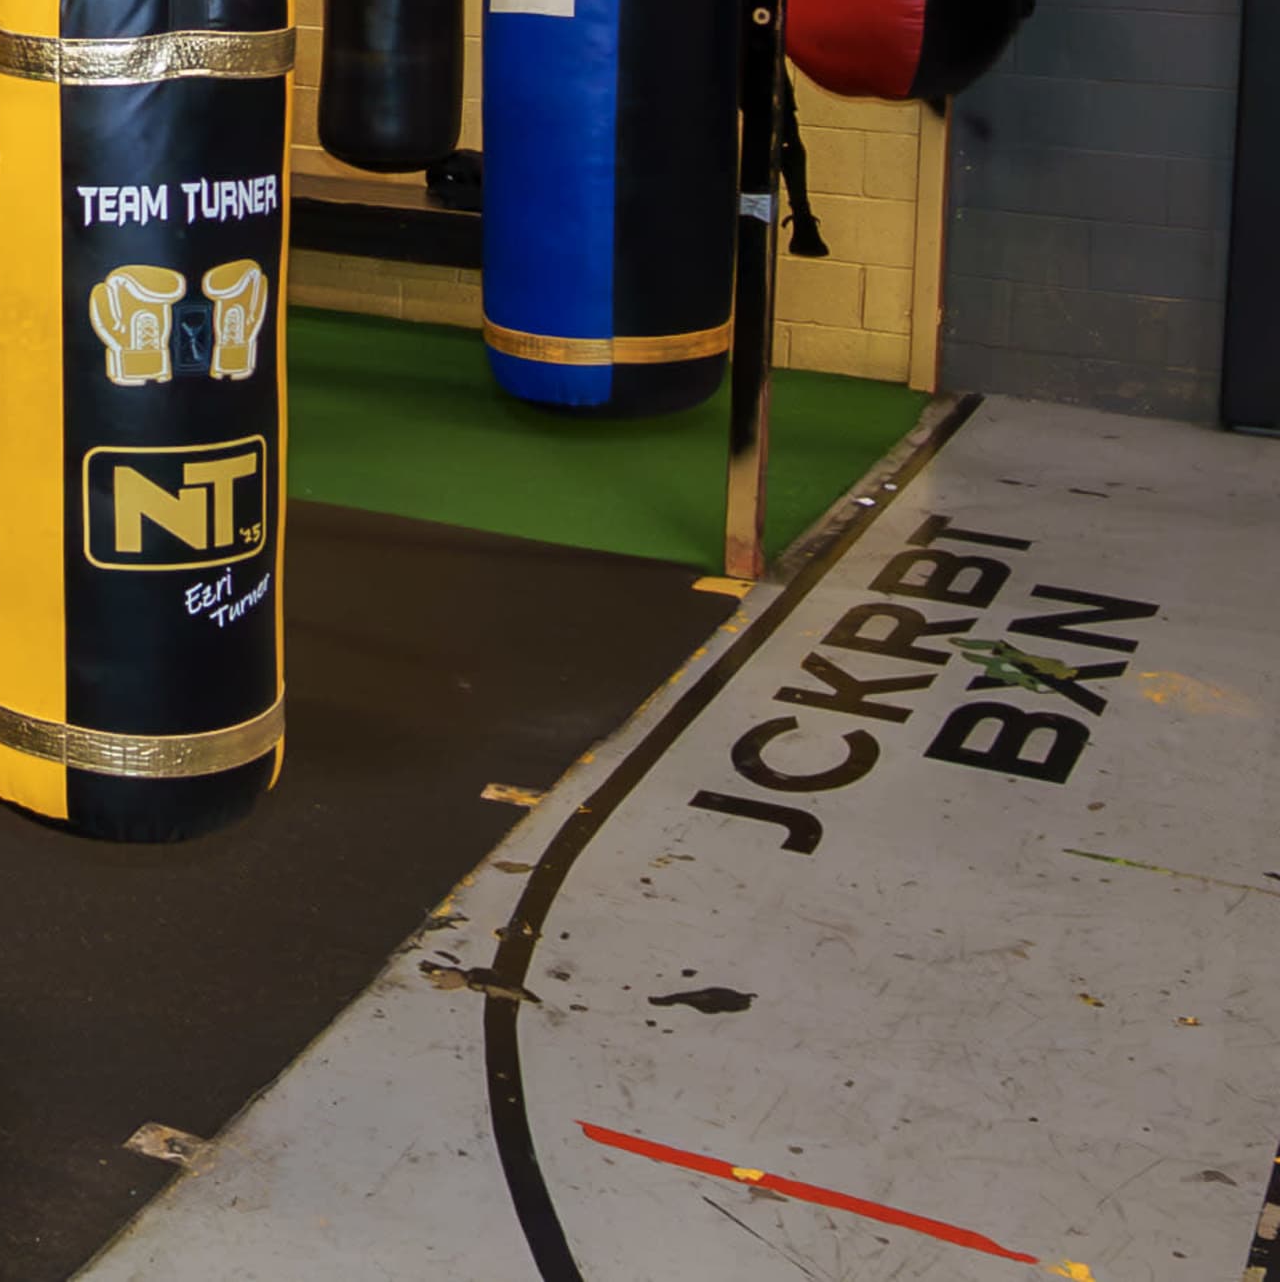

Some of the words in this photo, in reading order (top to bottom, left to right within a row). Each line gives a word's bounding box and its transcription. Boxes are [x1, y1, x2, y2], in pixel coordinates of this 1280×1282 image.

[76, 184, 168, 226] TEAM
[181, 174, 277, 225] TURNER
[114, 452, 257, 553] NT
[185, 567, 232, 614] Ezri
[209, 573, 270, 627] Turner
[687, 514, 1040, 856] JCKRBT
